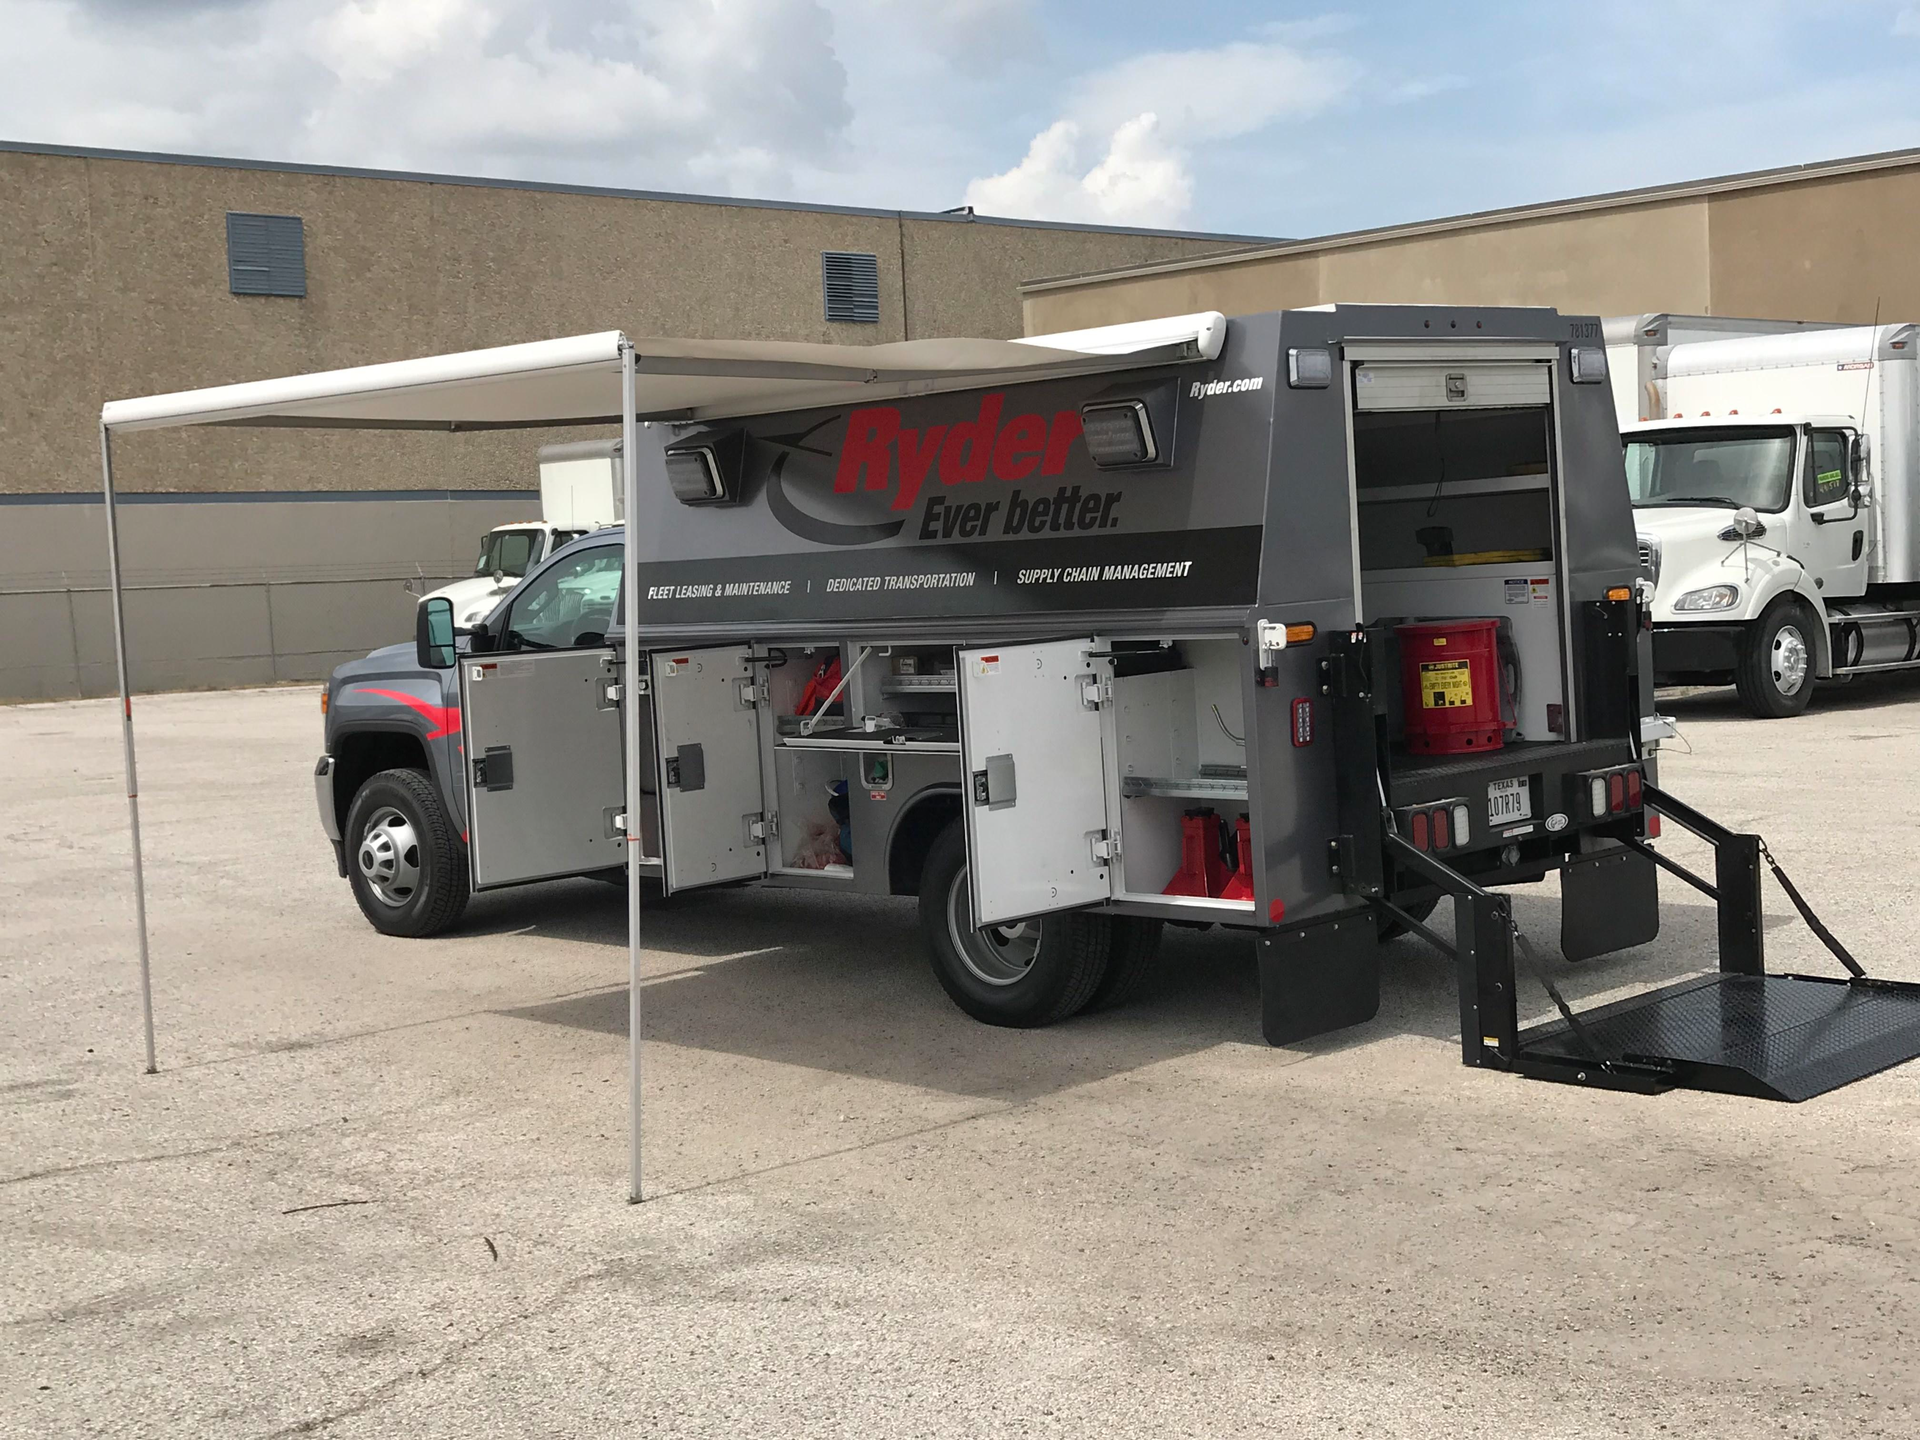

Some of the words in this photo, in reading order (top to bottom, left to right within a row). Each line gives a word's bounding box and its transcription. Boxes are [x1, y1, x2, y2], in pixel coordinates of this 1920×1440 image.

[1570, 323, 1599, 339] 781377
[1189, 376, 1264, 400] Ryder.com
[833, 392, 1085, 512] Ryder
[918, 496, 1000, 541] Ever
[1002, 485, 1123, 536] better.
[826, 576, 882, 592] DEDICATED
[883, 571, 976, 590] TRANSPORTATION
[1017, 568, 1062, 584] SUPPLY
[1062, 565, 1101, 582] CHAIN
[1101, 560, 1193, 581] MANAGEMENT
[648, 586, 675, 600] FLEET
[675, 583, 714, 599] LEASING
[714, 583, 723, 597] &
[723, 580, 792, 597] MAINTENANCE
[1493, 779, 1514, 791] TEXAS
[1487, 792, 1522, 817] 107R79
